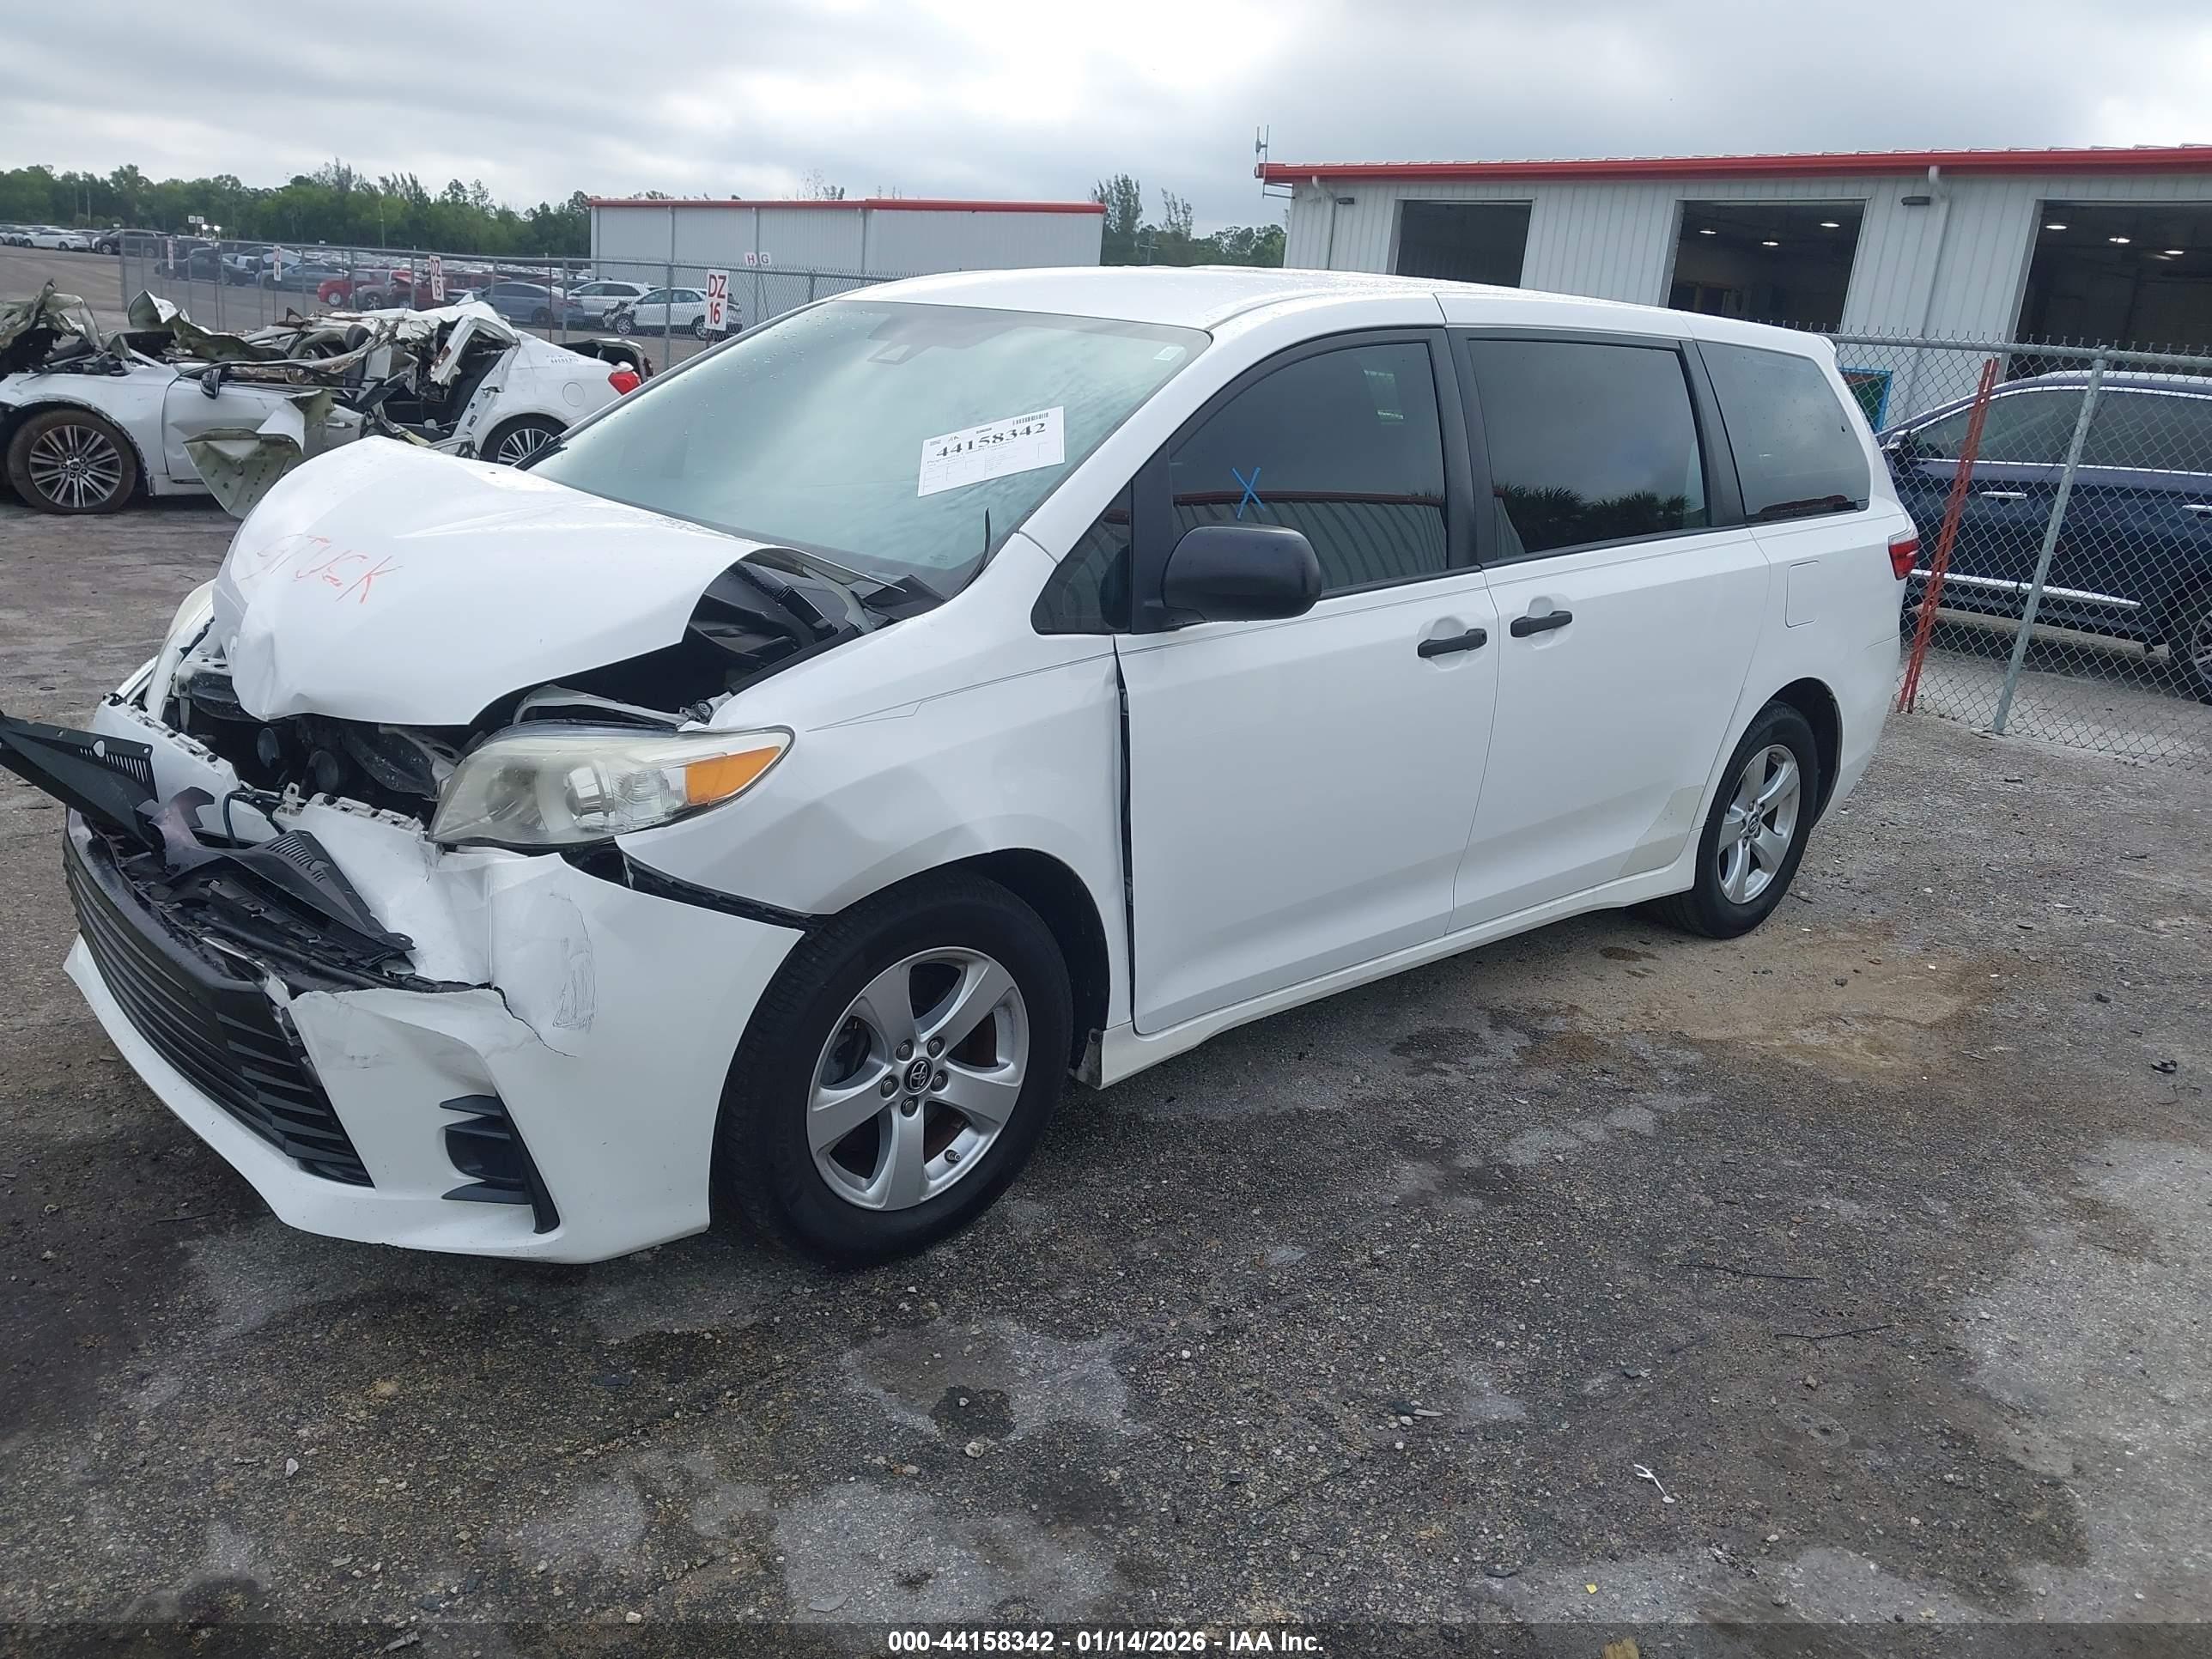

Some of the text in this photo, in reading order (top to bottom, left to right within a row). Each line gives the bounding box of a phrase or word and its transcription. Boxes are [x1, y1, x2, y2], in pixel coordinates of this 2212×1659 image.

[431, 258, 441, 277] DZ
[747, 254, 755, 264] H
[761, 253, 769, 264] G
[434, 280, 441, 296] 15
[708, 274, 727, 299] DZ
[709, 301, 721, 325] 16
[935, 422, 1047, 457] 44158342
